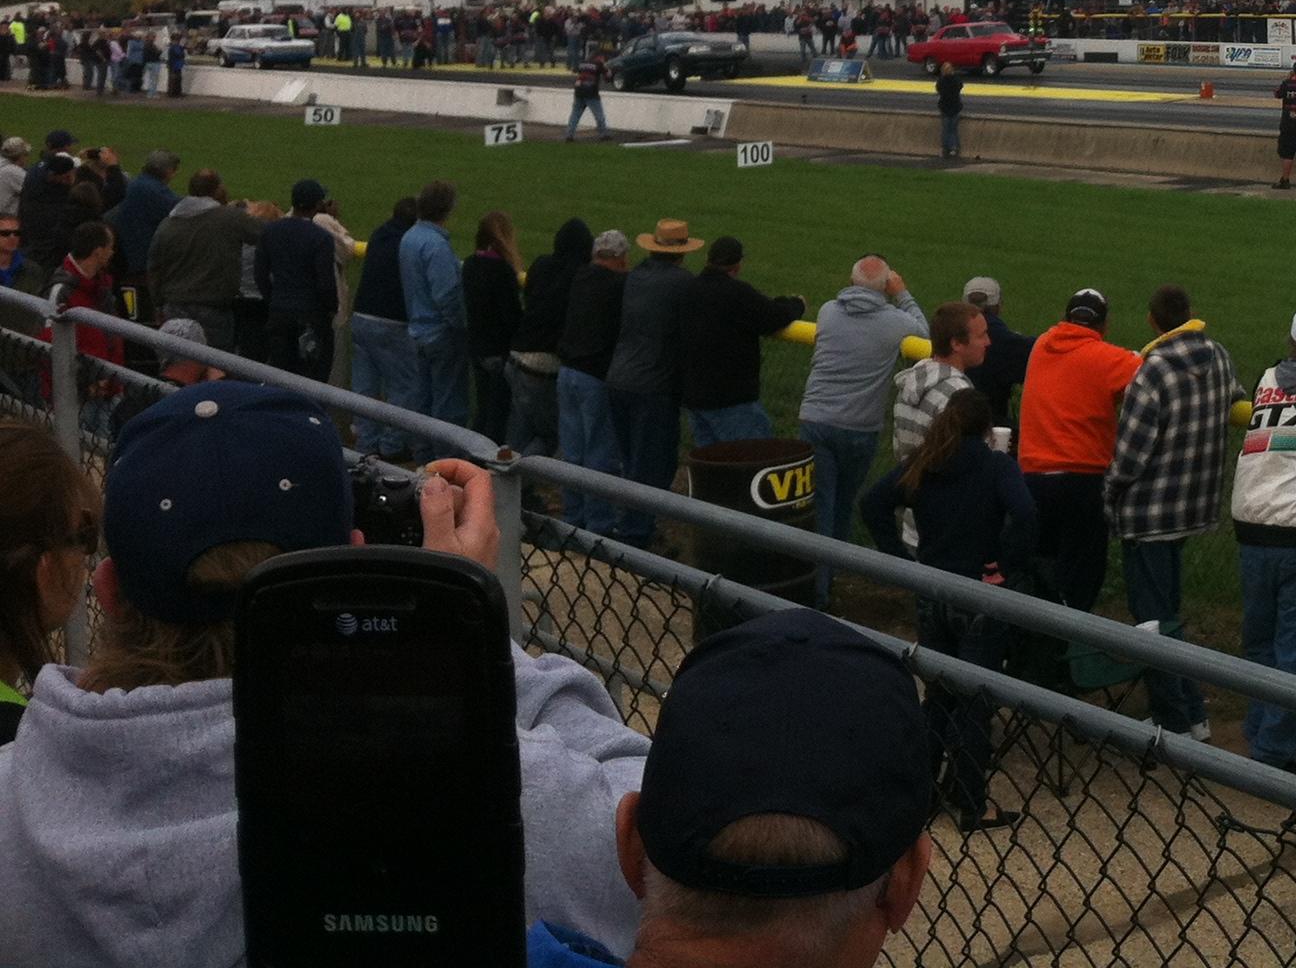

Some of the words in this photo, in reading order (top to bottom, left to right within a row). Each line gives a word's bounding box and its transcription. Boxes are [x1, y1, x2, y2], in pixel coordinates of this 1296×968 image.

[312, 108, 334, 122] 50
[491, 124, 517, 143] 75
[740, 143, 770, 164] 100
[766, 461, 815, 501] VH
[362, 616, 398, 631] at&t
[324, 914, 438, 932] SAMSUNG
